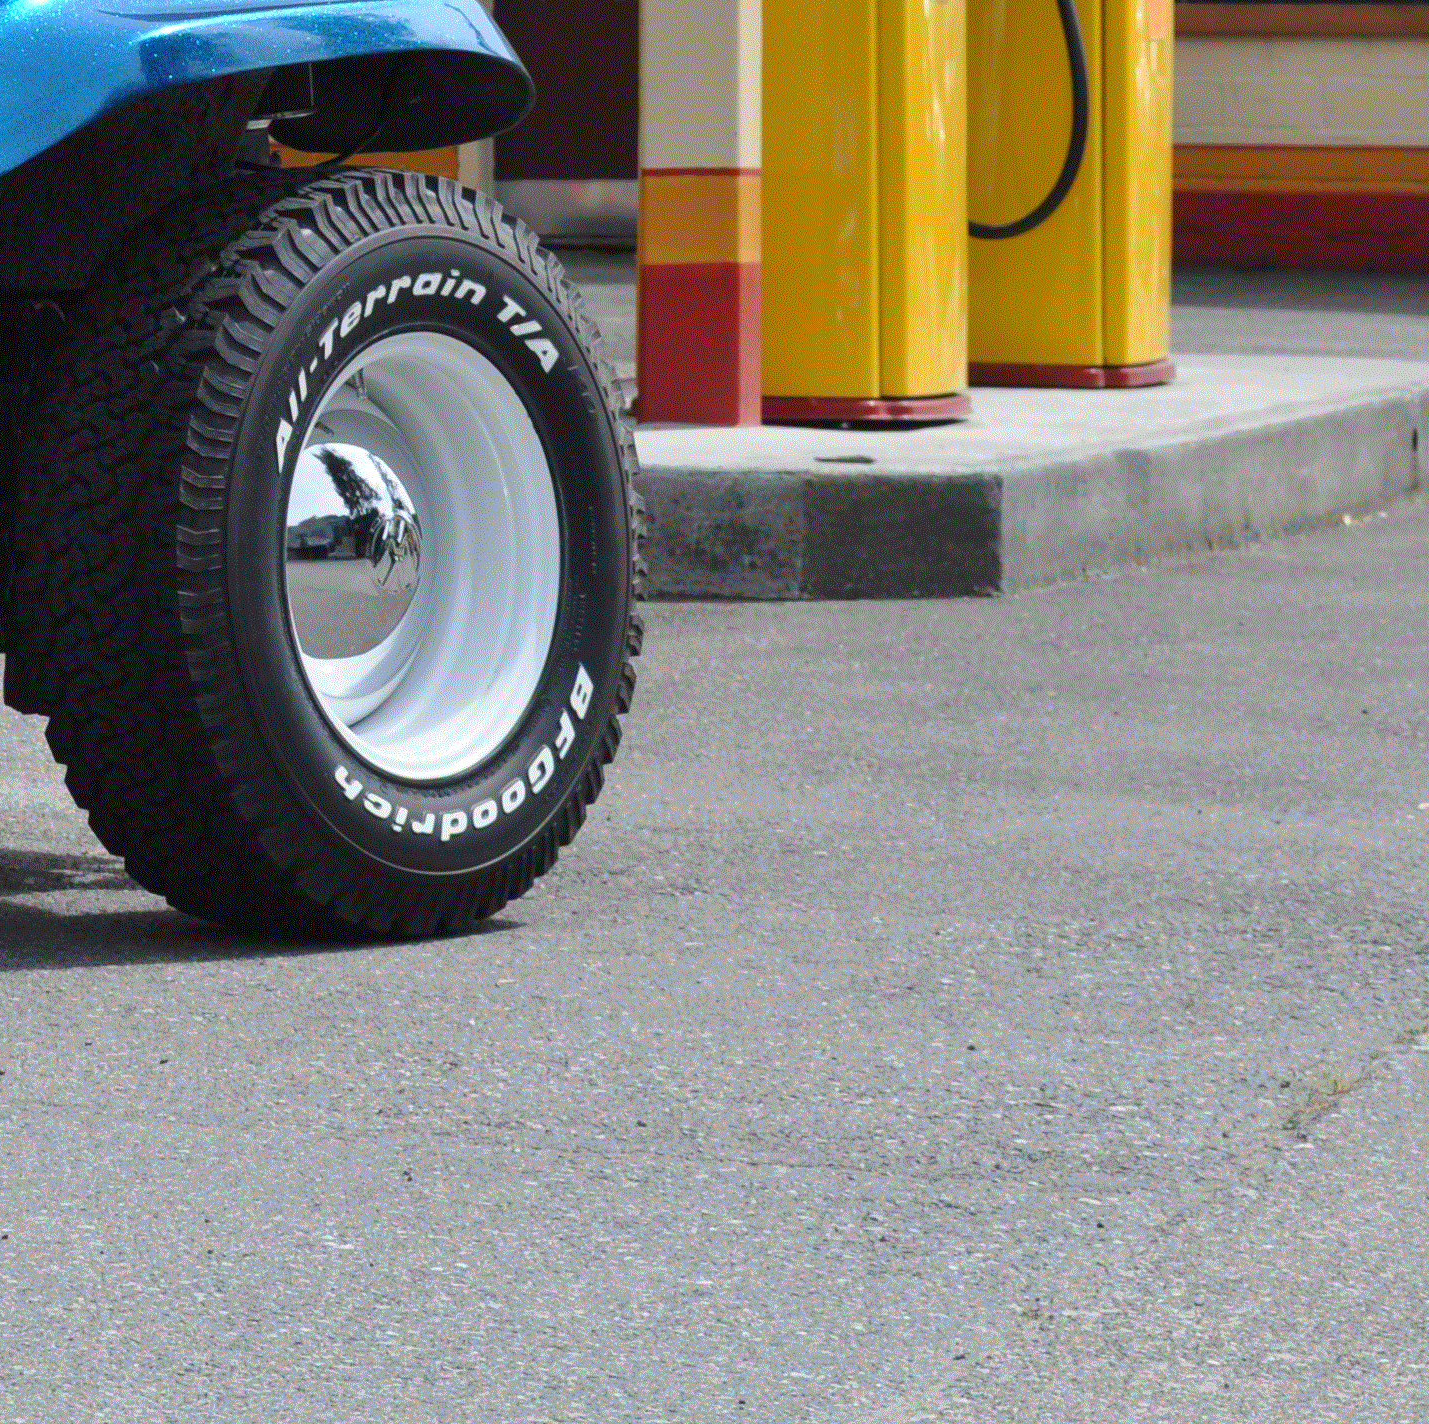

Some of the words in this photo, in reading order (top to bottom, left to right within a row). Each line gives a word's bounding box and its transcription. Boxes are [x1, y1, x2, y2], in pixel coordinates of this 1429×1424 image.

[275, 268, 487, 474] All-Terrain
[497, 294, 559, 374] T/A
[333, 663, 595, 843] BFGoodrich
